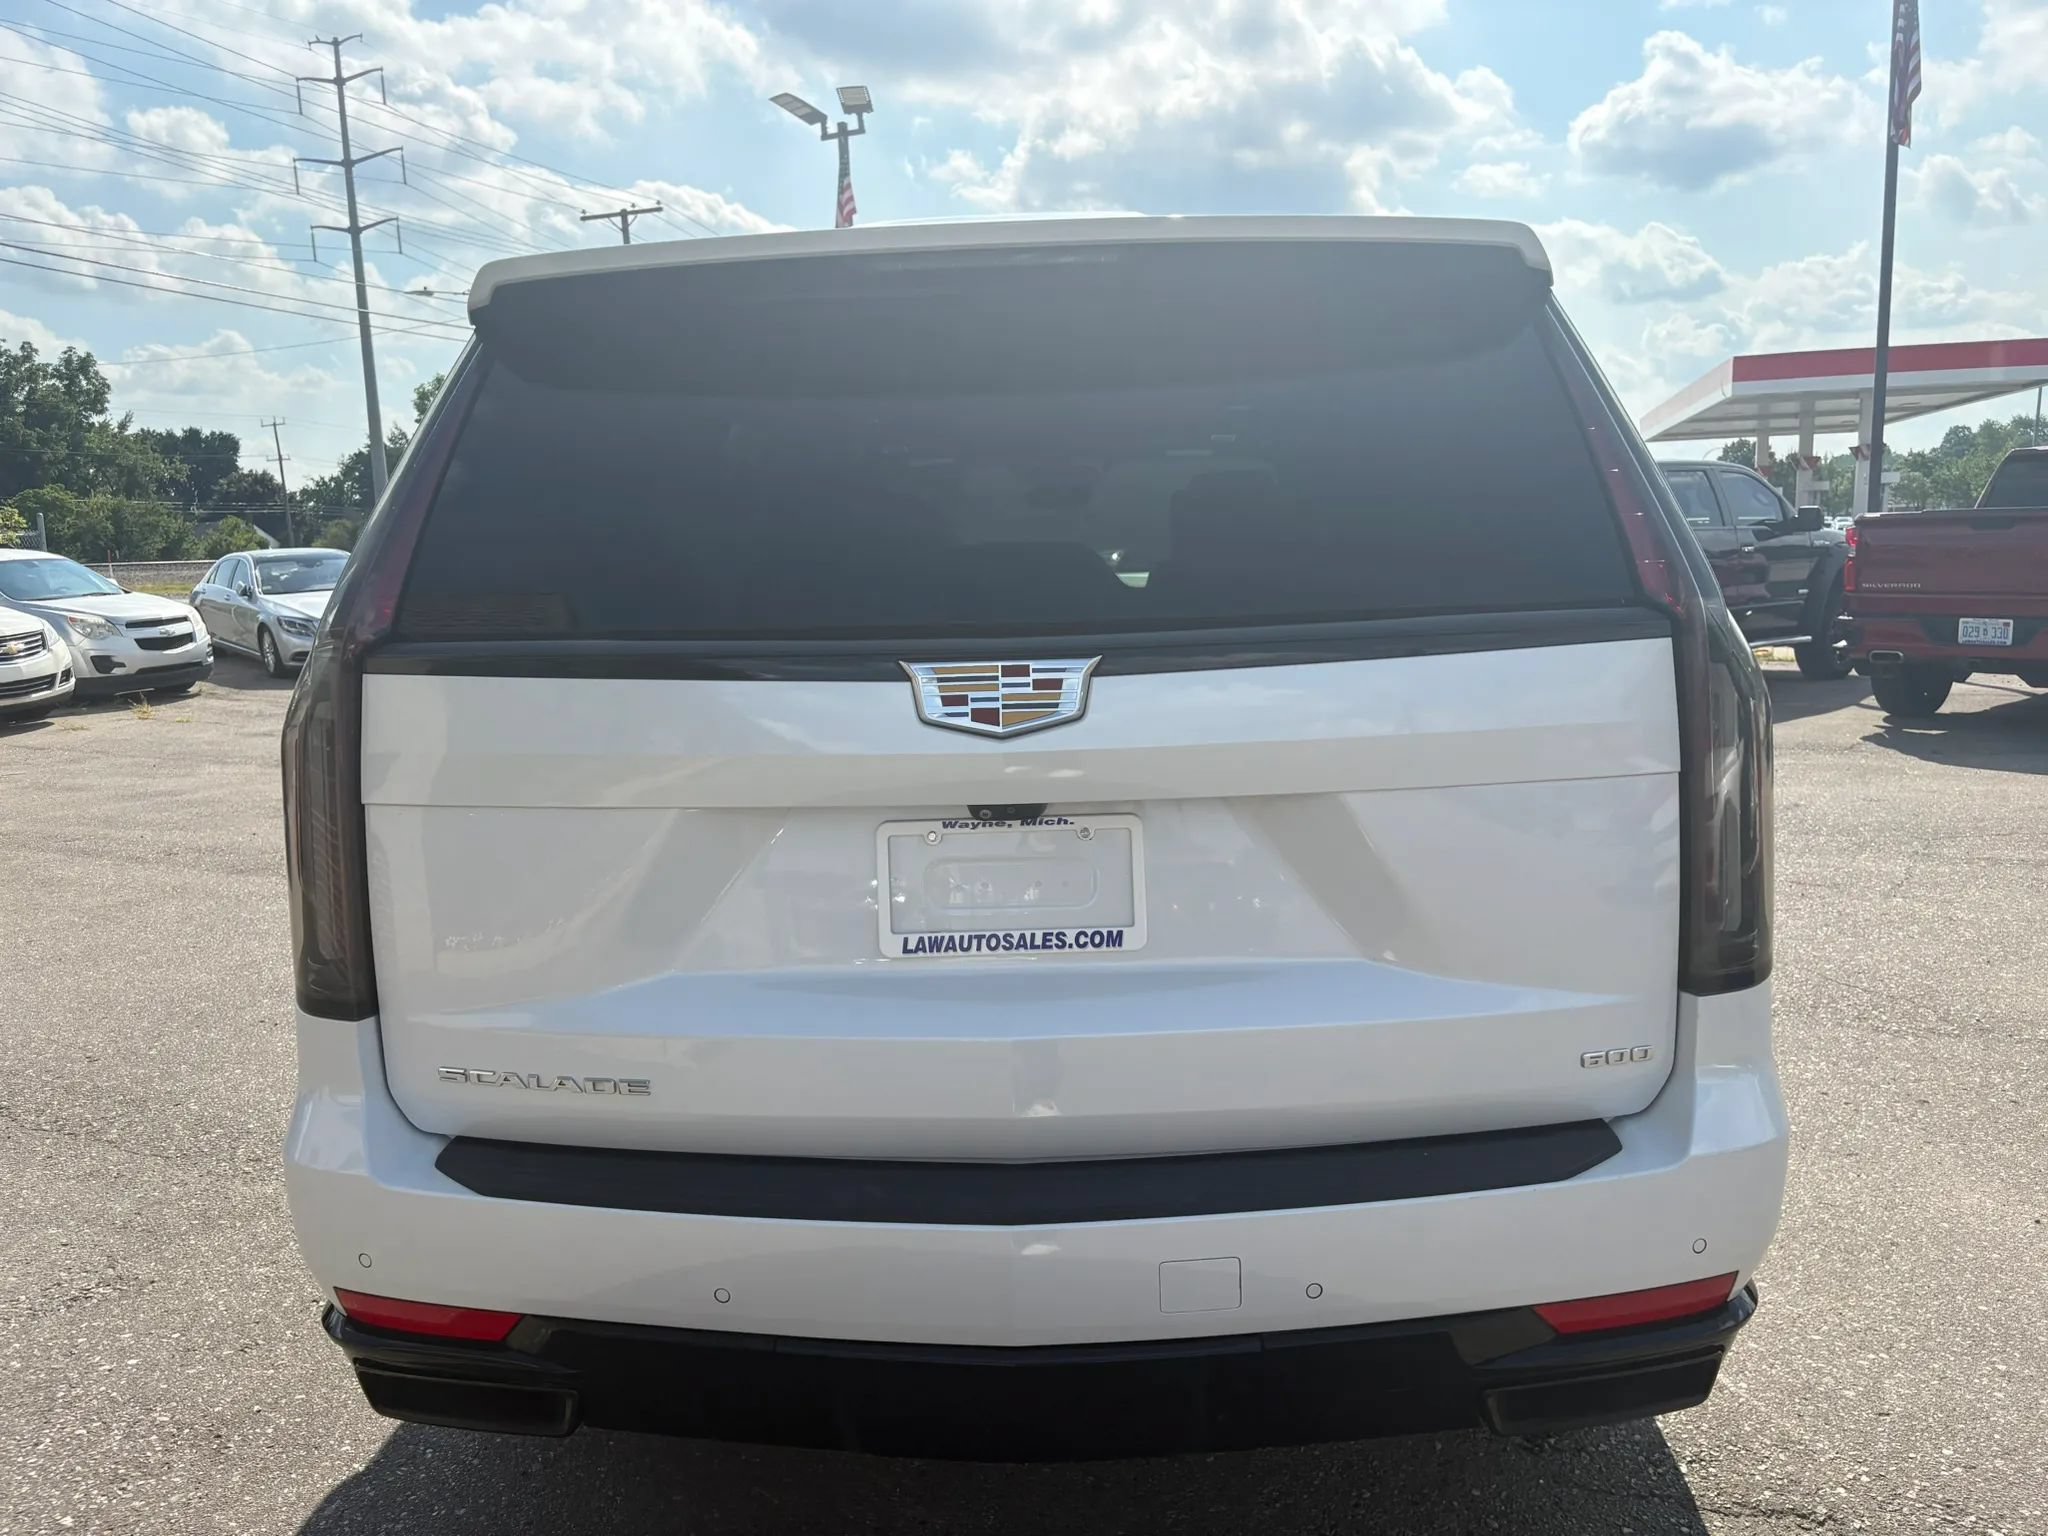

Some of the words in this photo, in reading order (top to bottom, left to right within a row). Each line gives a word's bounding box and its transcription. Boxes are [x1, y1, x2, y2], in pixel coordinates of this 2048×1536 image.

[941, 820, 1012, 830] Wayne,
[1020, 816, 1075, 827] Mich.
[902, 930, 1124, 955] LAWAUTOSALES.COM
[1580, 1045, 1655, 1068] 600
[437, 1066, 651, 1096] SCALADE
